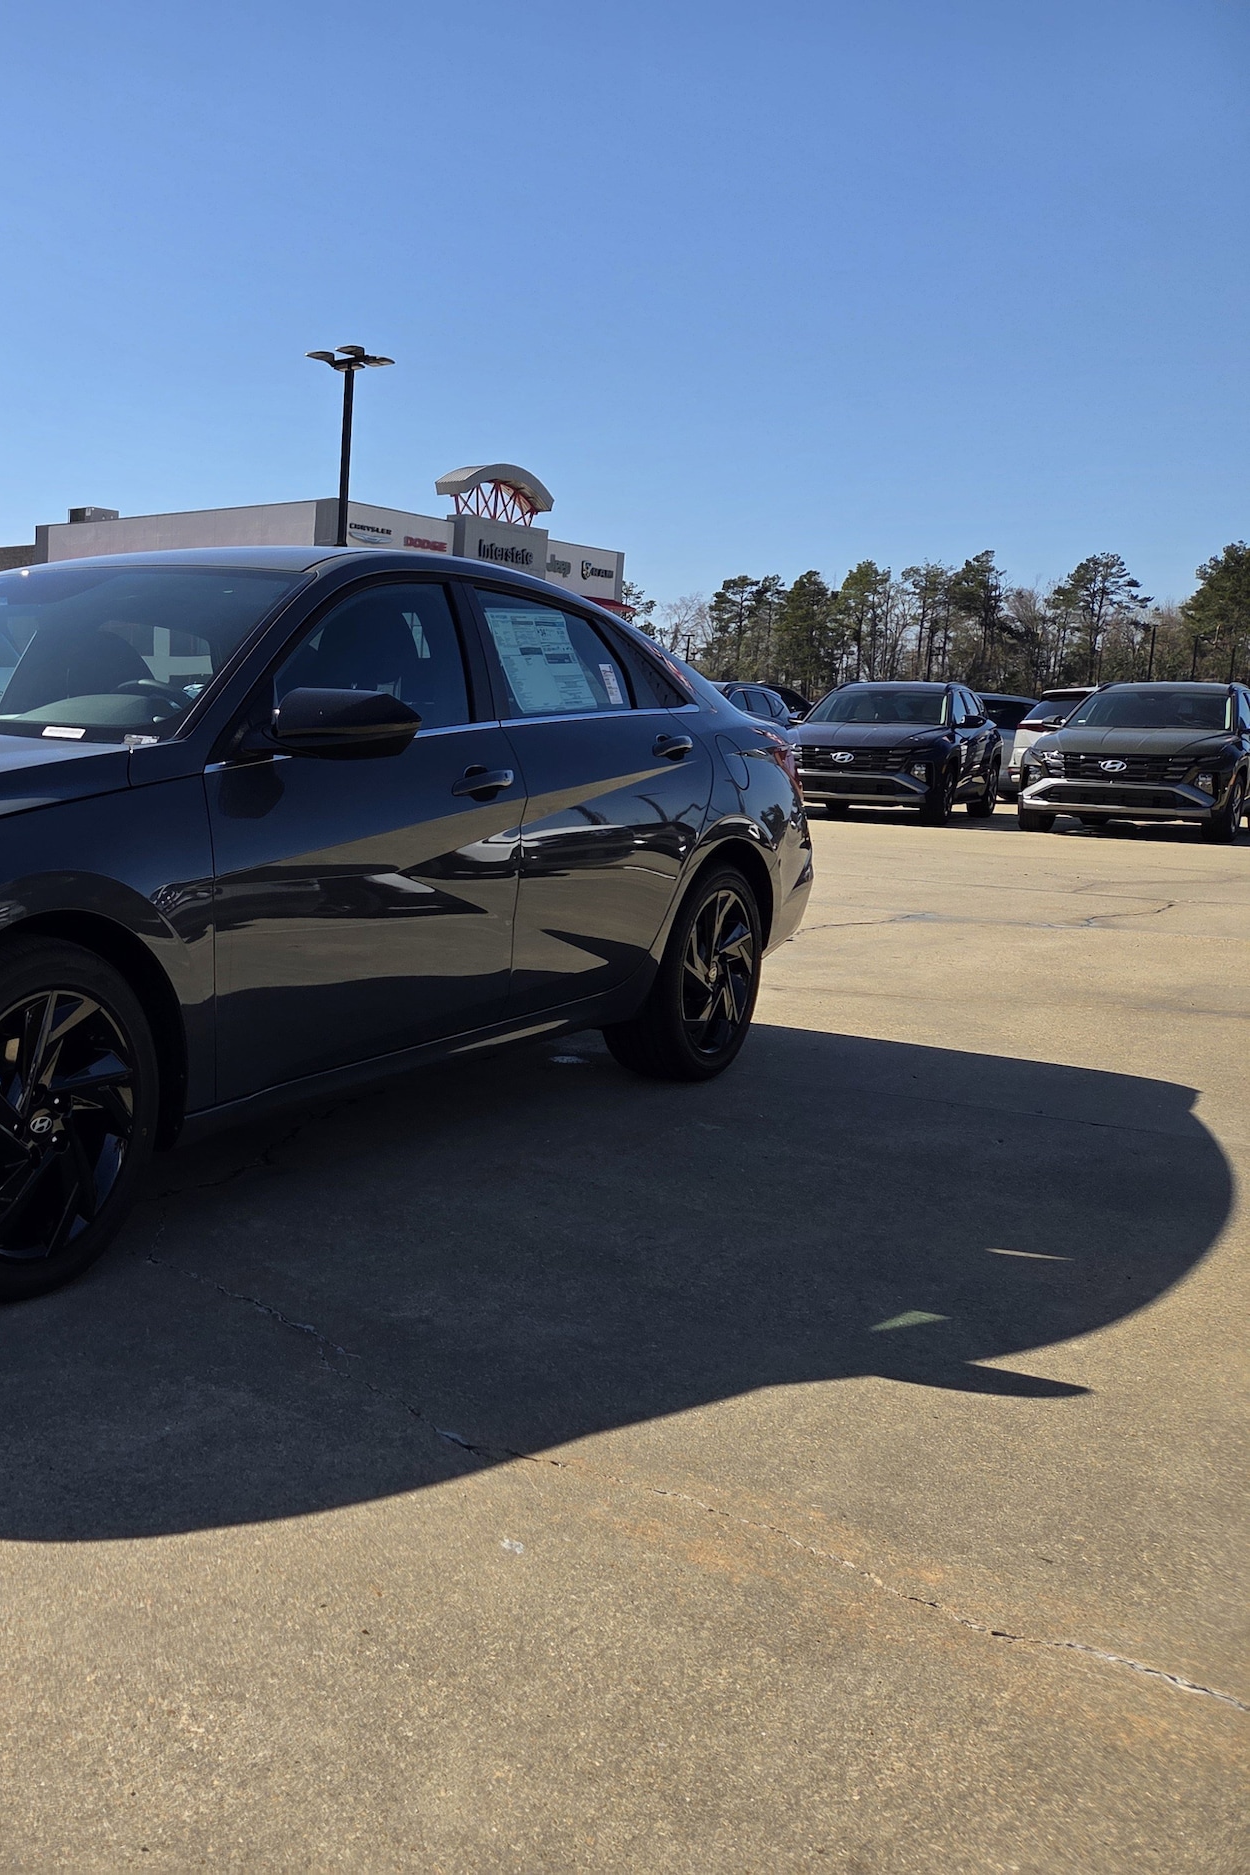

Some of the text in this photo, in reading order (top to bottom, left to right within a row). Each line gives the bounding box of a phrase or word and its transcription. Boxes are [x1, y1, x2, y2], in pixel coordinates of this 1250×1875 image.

[349, 522, 393, 536] CHRYSLER
[403, 536, 448, 552] DODGE
[477, 538, 534, 566] Interstate
[546, 553, 571, 579] Jeep
